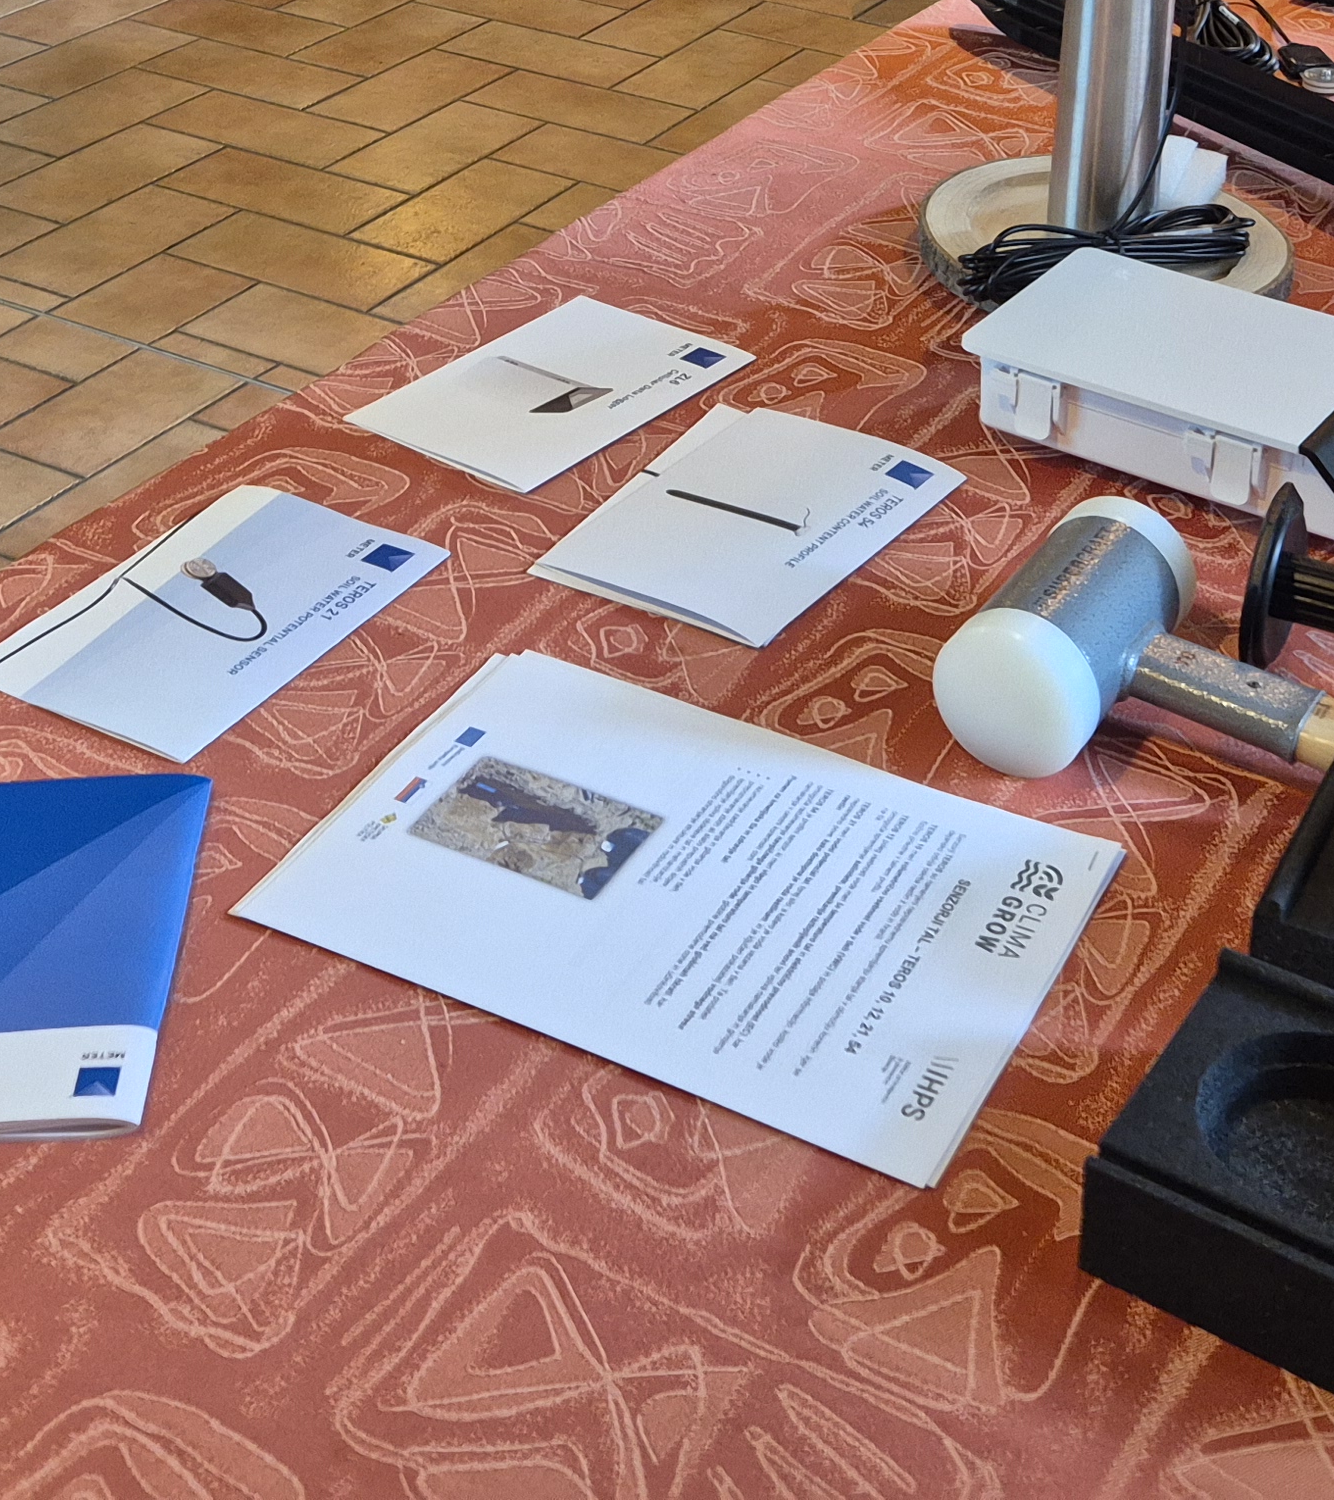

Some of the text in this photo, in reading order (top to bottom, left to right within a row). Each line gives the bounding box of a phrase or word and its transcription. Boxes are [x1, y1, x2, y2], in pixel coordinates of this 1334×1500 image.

[667, 342, 692, 356] METER
[669, 372, 691, 385] ZL6
[870, 454, 894, 471] METER
[857, 495, 903, 527] TEROS 54
[784, 488, 888, 568] SOIL WATER CONTENT PROFILE
[346, 538, 374, 557] METER
[320, 581, 376, 620] TEROS 21
[228, 575, 360, 674] SOIL WATER POTENTIAL SENSOR
[932, 879, 970, 925] SENZORJI
[975, 896, 1022, 952] GROW
[998, 903, 1046, 957] CLIMA
[917, 927, 939, 943] TAL
[888, 955, 920, 989] TEROS
[875, 991, 895, 1003] 10,
[864, 1007, 883, 1019] 12,
[852, 1022, 873, 1036] 21,
[80, 1050, 126, 1061] METER
[844, 1040, 861, 1054] 54
